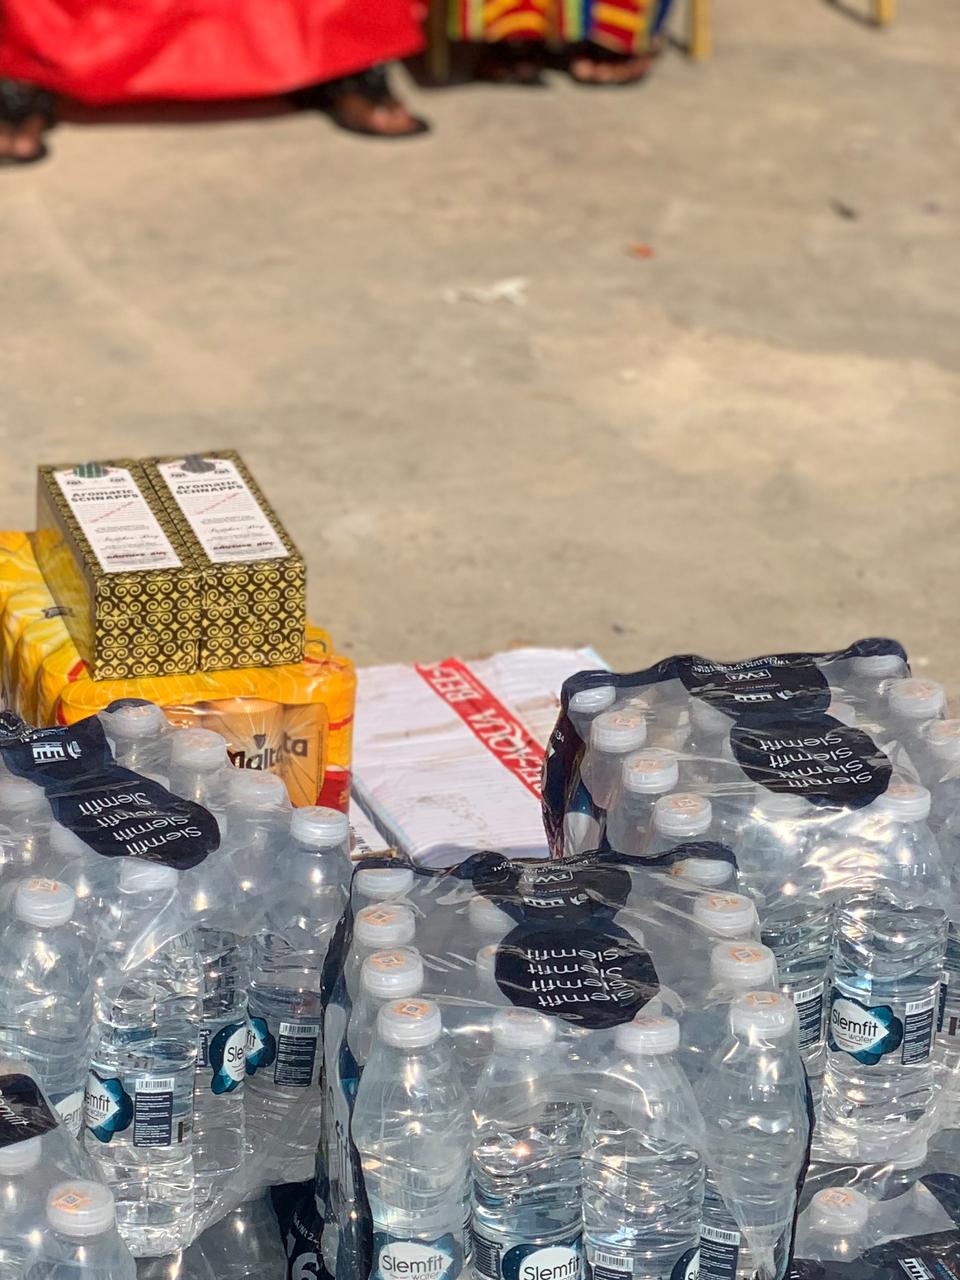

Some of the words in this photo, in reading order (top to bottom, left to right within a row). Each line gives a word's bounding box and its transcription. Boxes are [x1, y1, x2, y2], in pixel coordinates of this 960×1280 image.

[72, 488, 134, 498] Aromatic
[175, 484, 244, 495] SCHNAPPS
[177, 480, 239, 490] Aromatic
[70, 493, 139, 502] SCHNAPPS
[760, 735, 842, 751] Slemfit
[770, 747, 852, 768] Slemfit
[78, 792, 151, 817] Slemfit
[112, 815, 189, 842] Slemfit
[127, 826, 202, 857] Slemfit
[527, 949, 620, 963] Slemfit
[528, 963, 622, 979] Slemfit
[530, 979, 628, 992] Slemfit
[538, 989, 635, 1007] Slemfit
[832, 1008, 879, 1038] Slemfit
[381, 1254, 444, 1274] Slemfit
